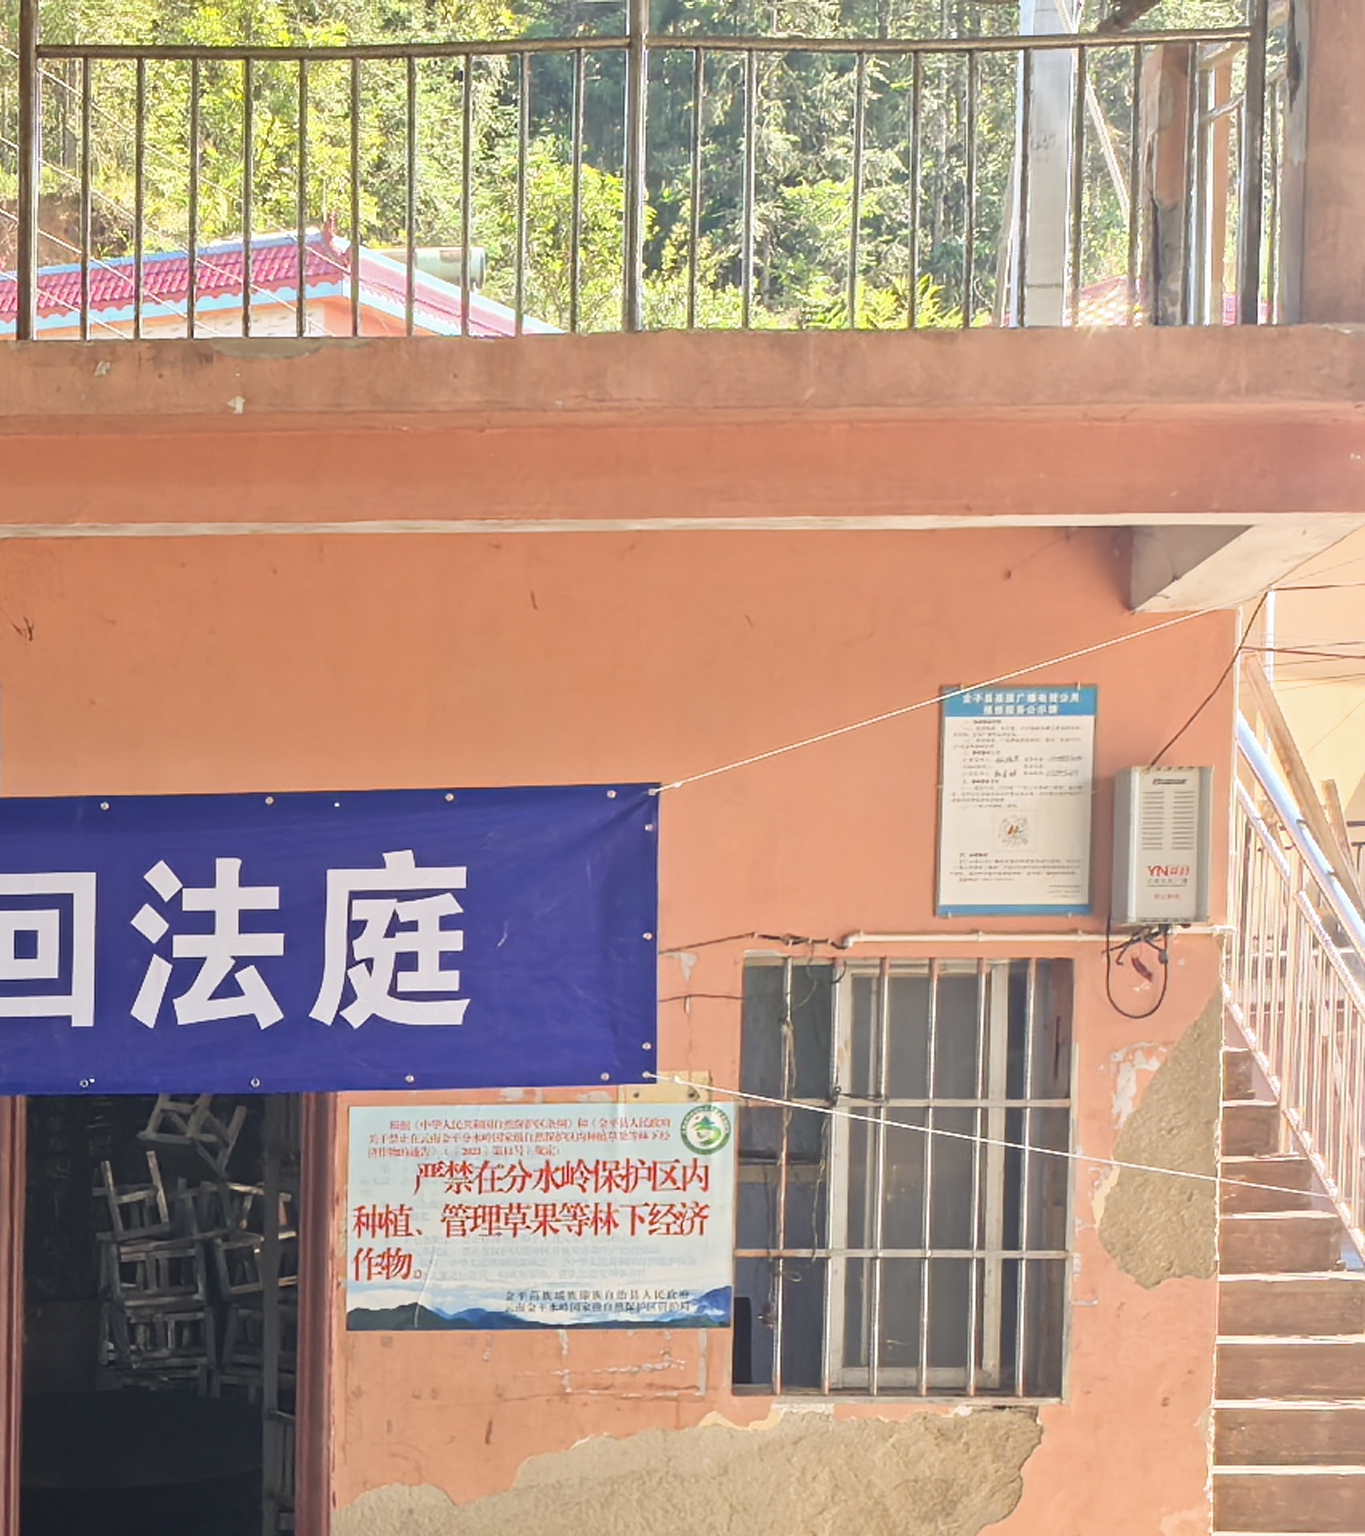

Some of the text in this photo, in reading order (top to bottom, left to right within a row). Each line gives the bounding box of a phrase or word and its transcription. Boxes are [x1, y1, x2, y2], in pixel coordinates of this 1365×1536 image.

[412, 1158, 711, 1196] 严禁在分水岭保护区内
[352, 1201, 711, 1239] 种植、管理草果等林下经济
[352, 1247, 424, 1282] 作物。
